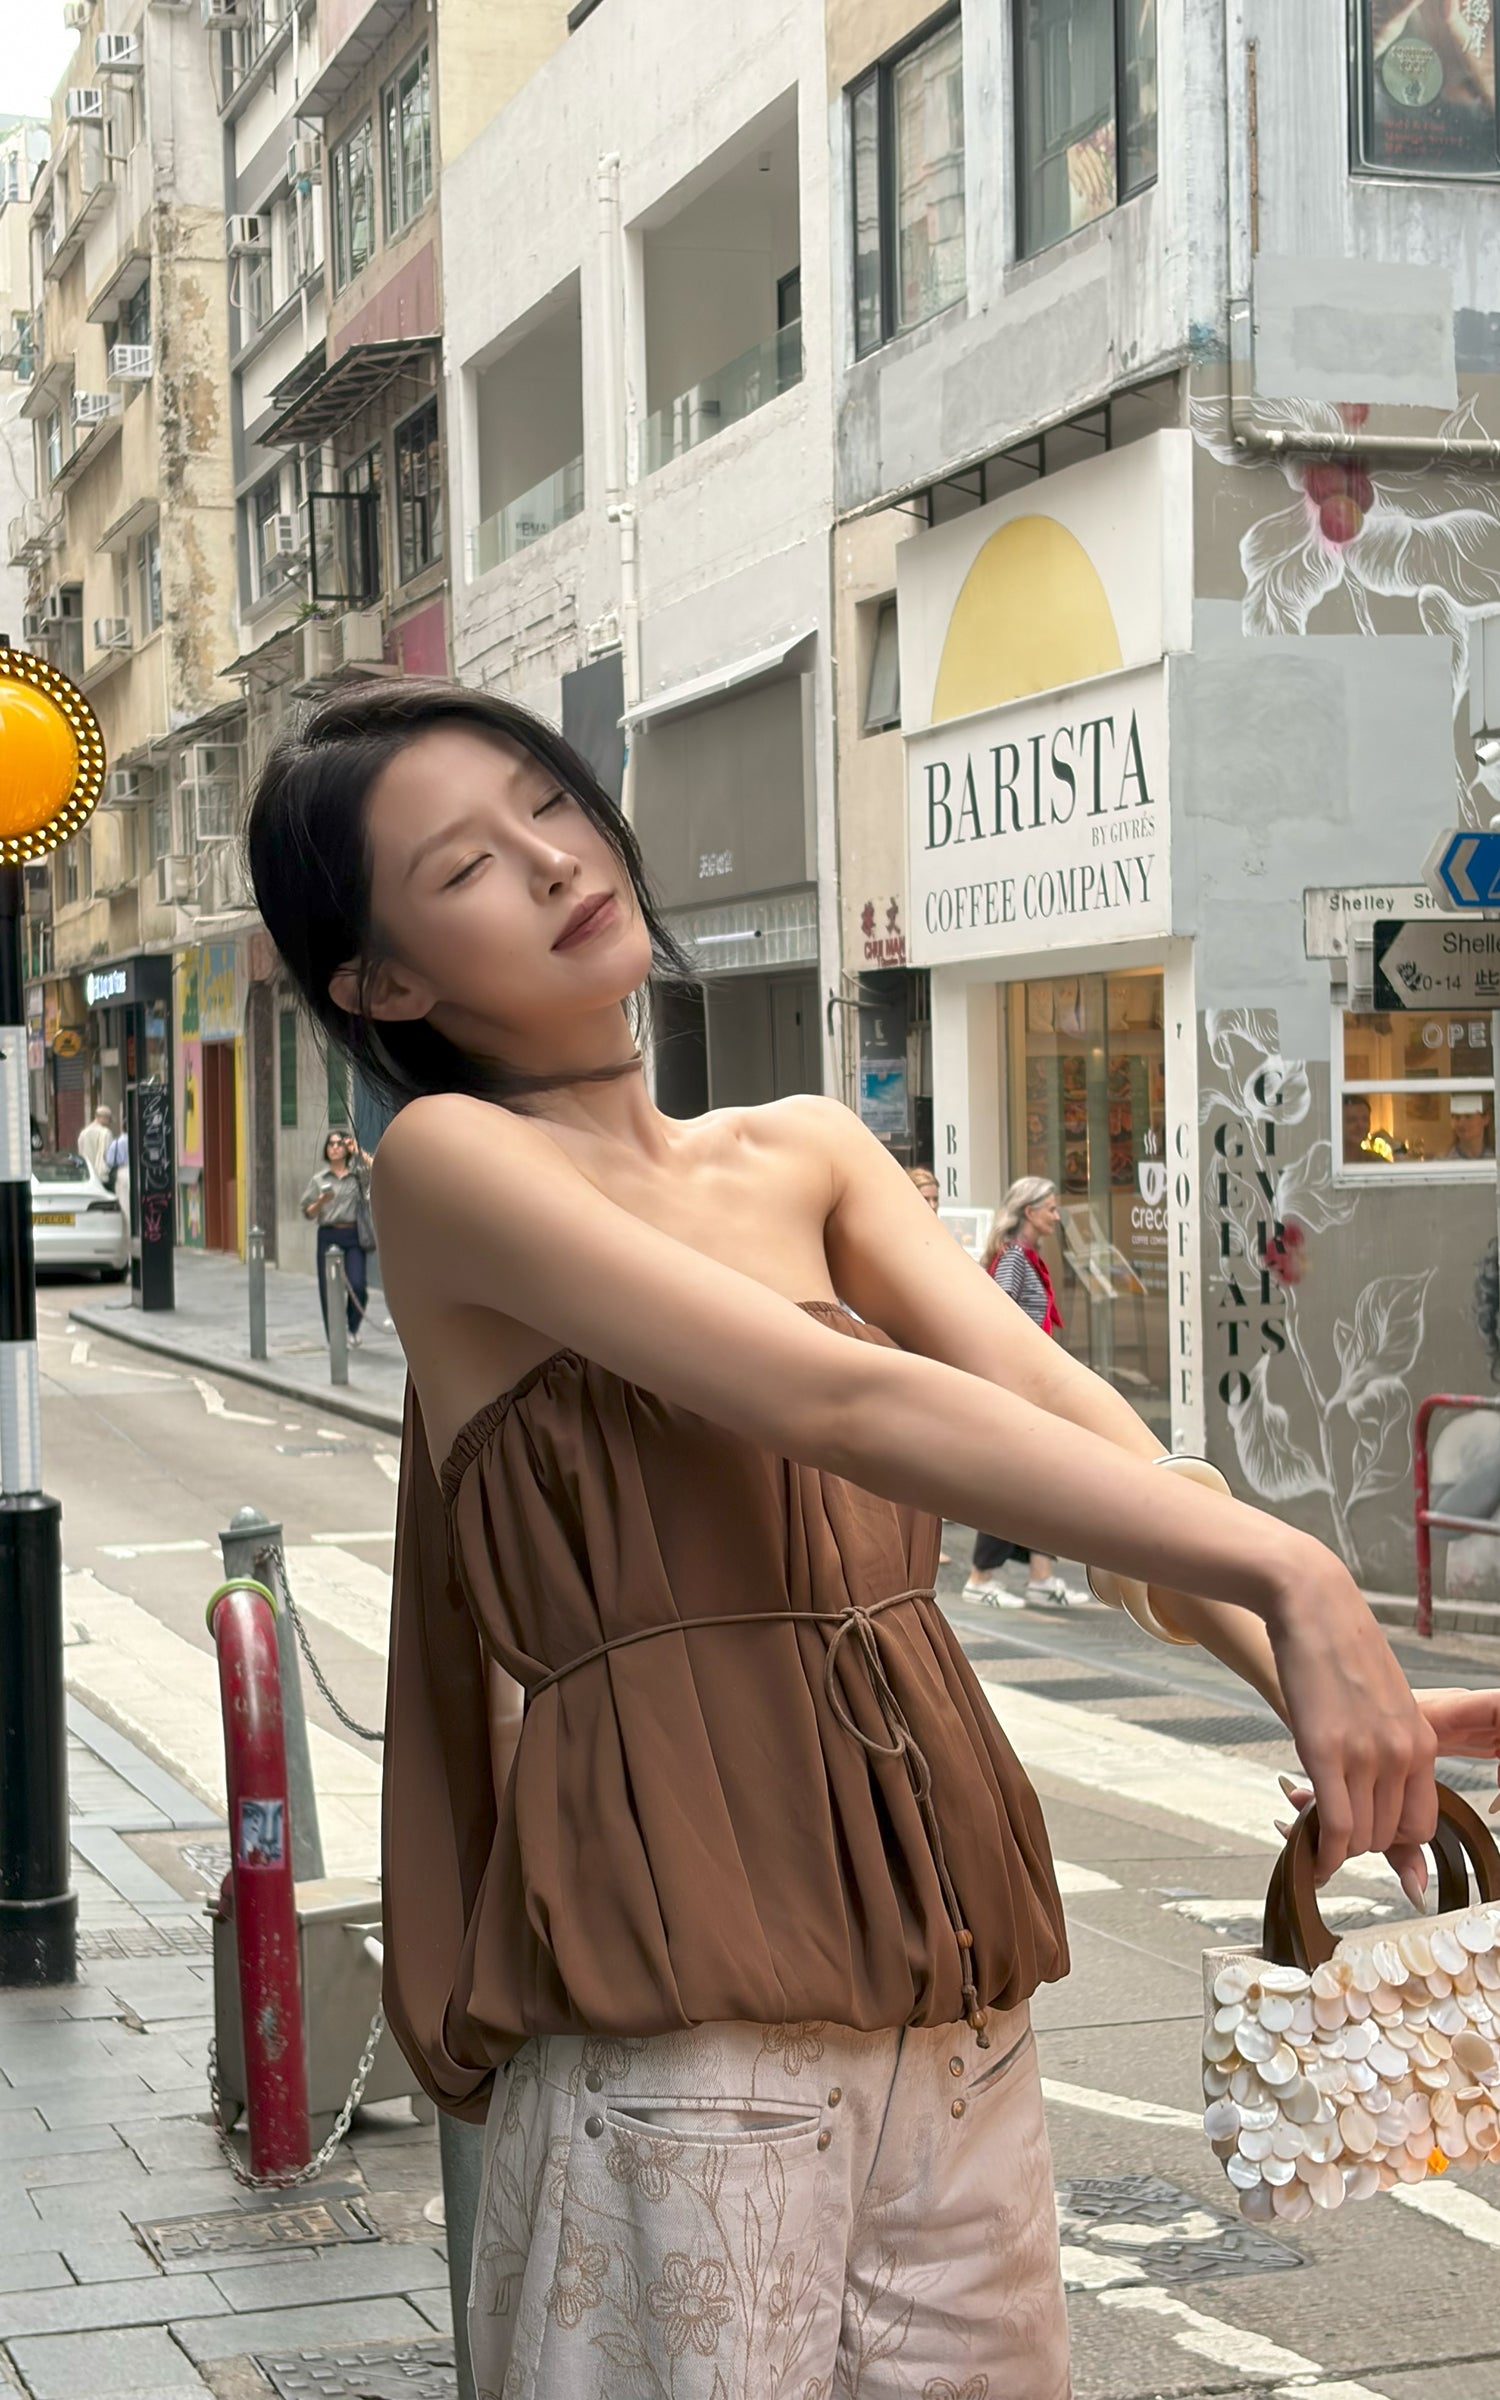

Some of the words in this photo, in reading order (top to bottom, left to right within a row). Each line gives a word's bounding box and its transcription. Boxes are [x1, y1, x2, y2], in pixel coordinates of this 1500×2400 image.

[923, 707, 1155, 851] BARISTA
[1091, 826, 1108, 847] BY
[925, 878, 1017, 935] COFFEE
[1023, 854, 1156, 921] COMPANY
[1329, 893, 1394, 913] Shelley
[1175, 1122, 1193, 1407] COFFEE
